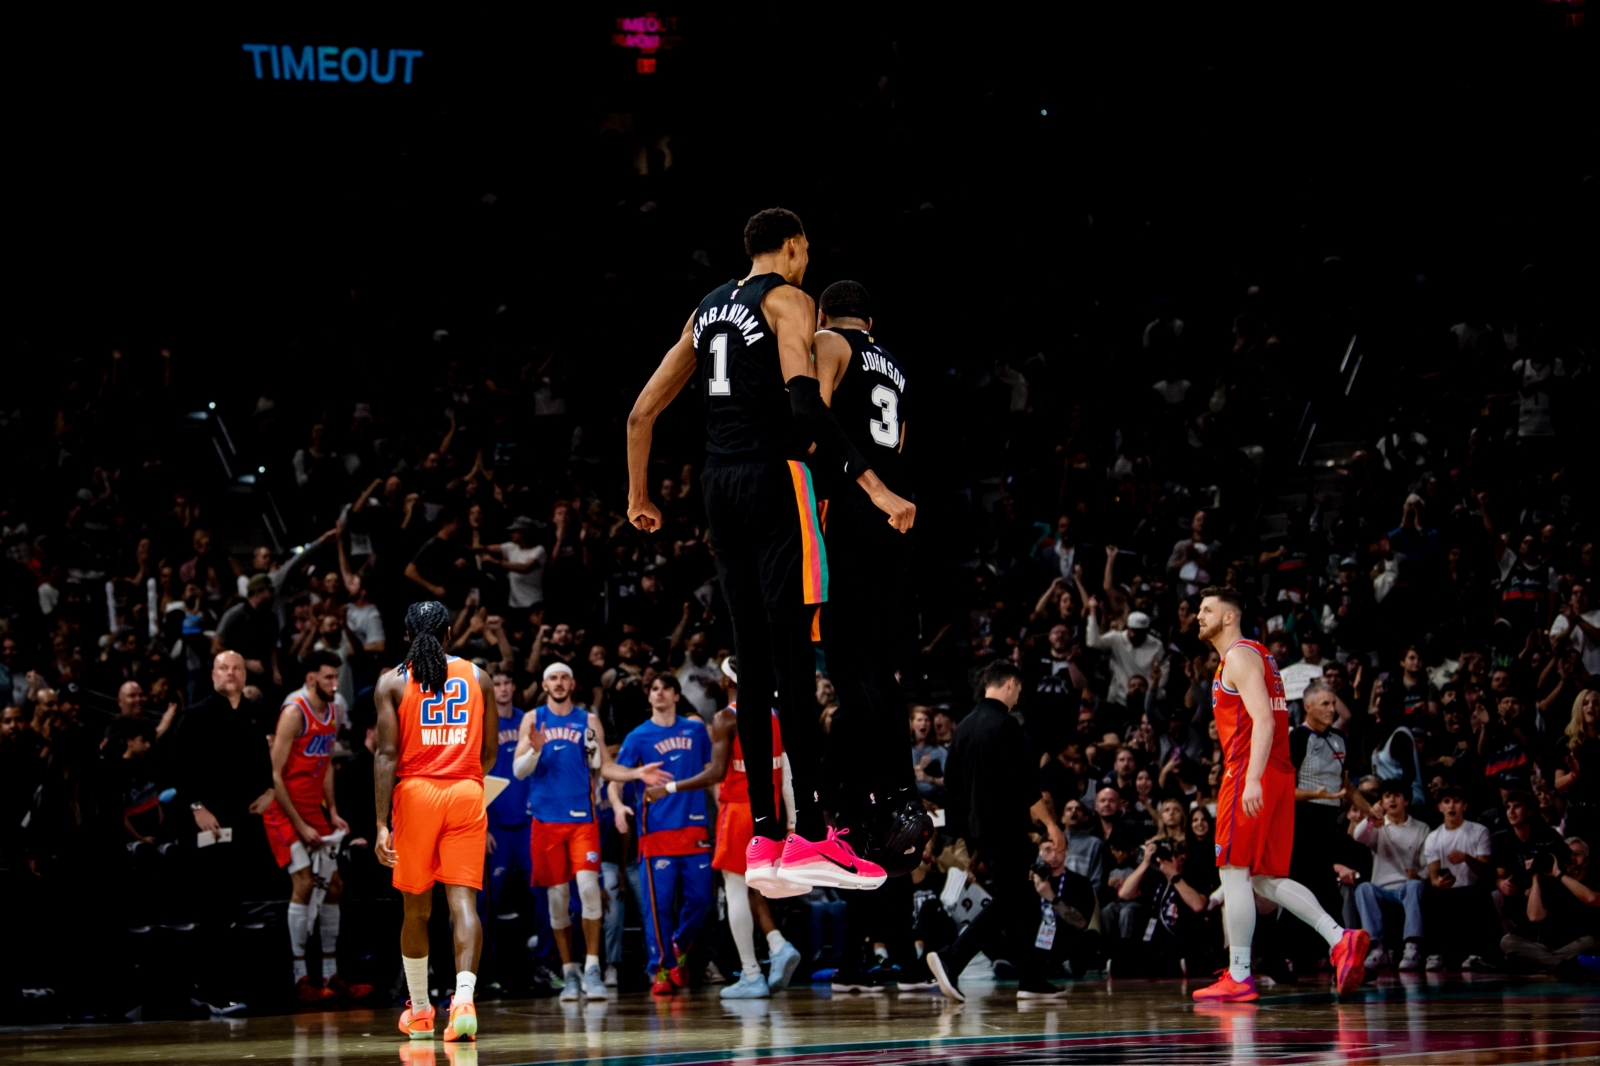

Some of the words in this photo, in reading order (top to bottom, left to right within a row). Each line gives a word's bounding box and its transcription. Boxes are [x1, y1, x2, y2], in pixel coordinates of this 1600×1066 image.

[241, 43, 424, 85] TIMEOUT
[708, 333, 731, 396] 1
[861, 351, 906, 394] JOHNSON
[869, 383, 900, 449] 3
[420, 677, 469, 727] 22
[421, 727, 468, 746] WALLACE
[544, 727, 582, 744] HUNDER
[653, 736, 693, 755] THUNDER
